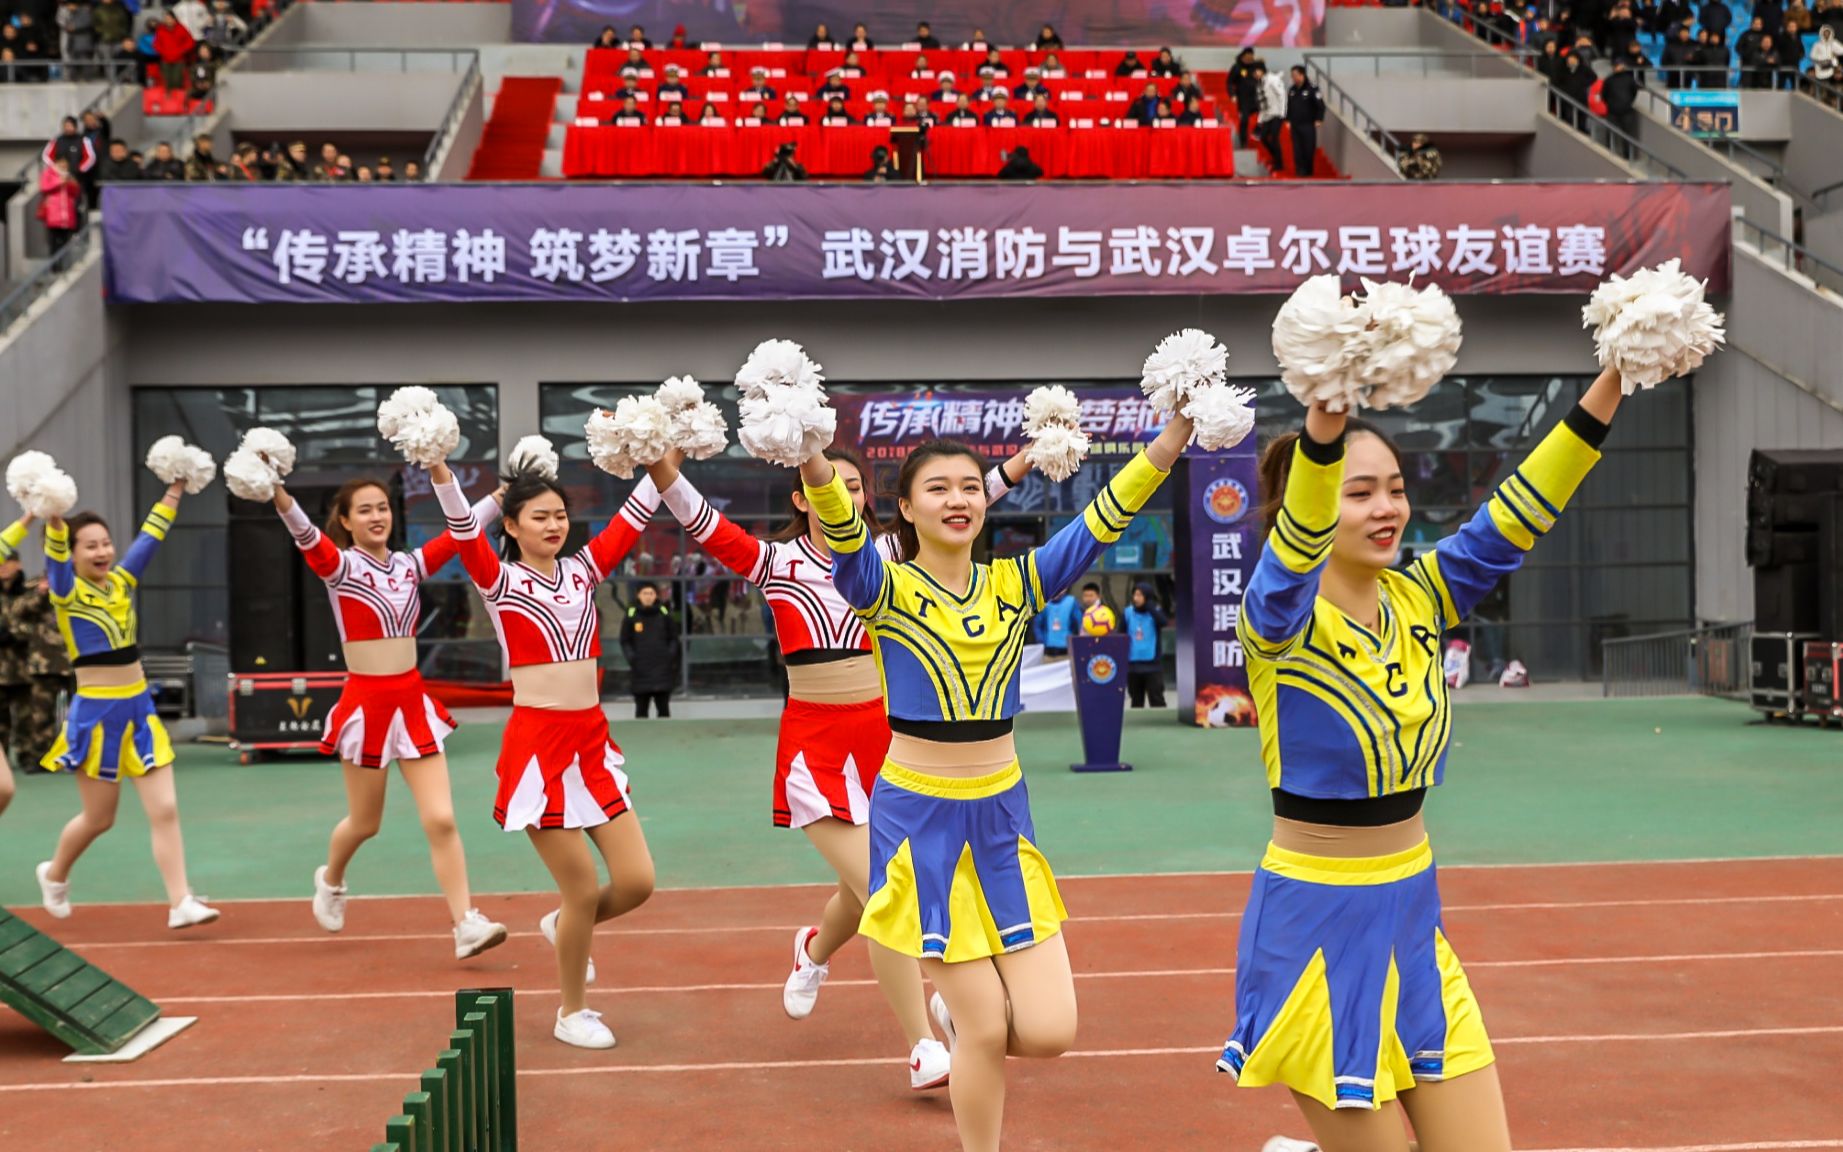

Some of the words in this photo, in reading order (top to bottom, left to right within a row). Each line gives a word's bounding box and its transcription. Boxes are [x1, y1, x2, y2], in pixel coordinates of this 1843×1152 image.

[242, 227, 506, 284] “传承精神
[528, 225, 789, 282] 筑梦新章”
[821, 224, 1606, 281] 武汉消防与武汉卓尔足球友谊赛
[859, 397, 1026, 443] 传承精神
[521, 573, 588, 605] TCA
[1212, 532, 1244, 668] 武汉消防
[915, 591, 1020, 638] TCA
